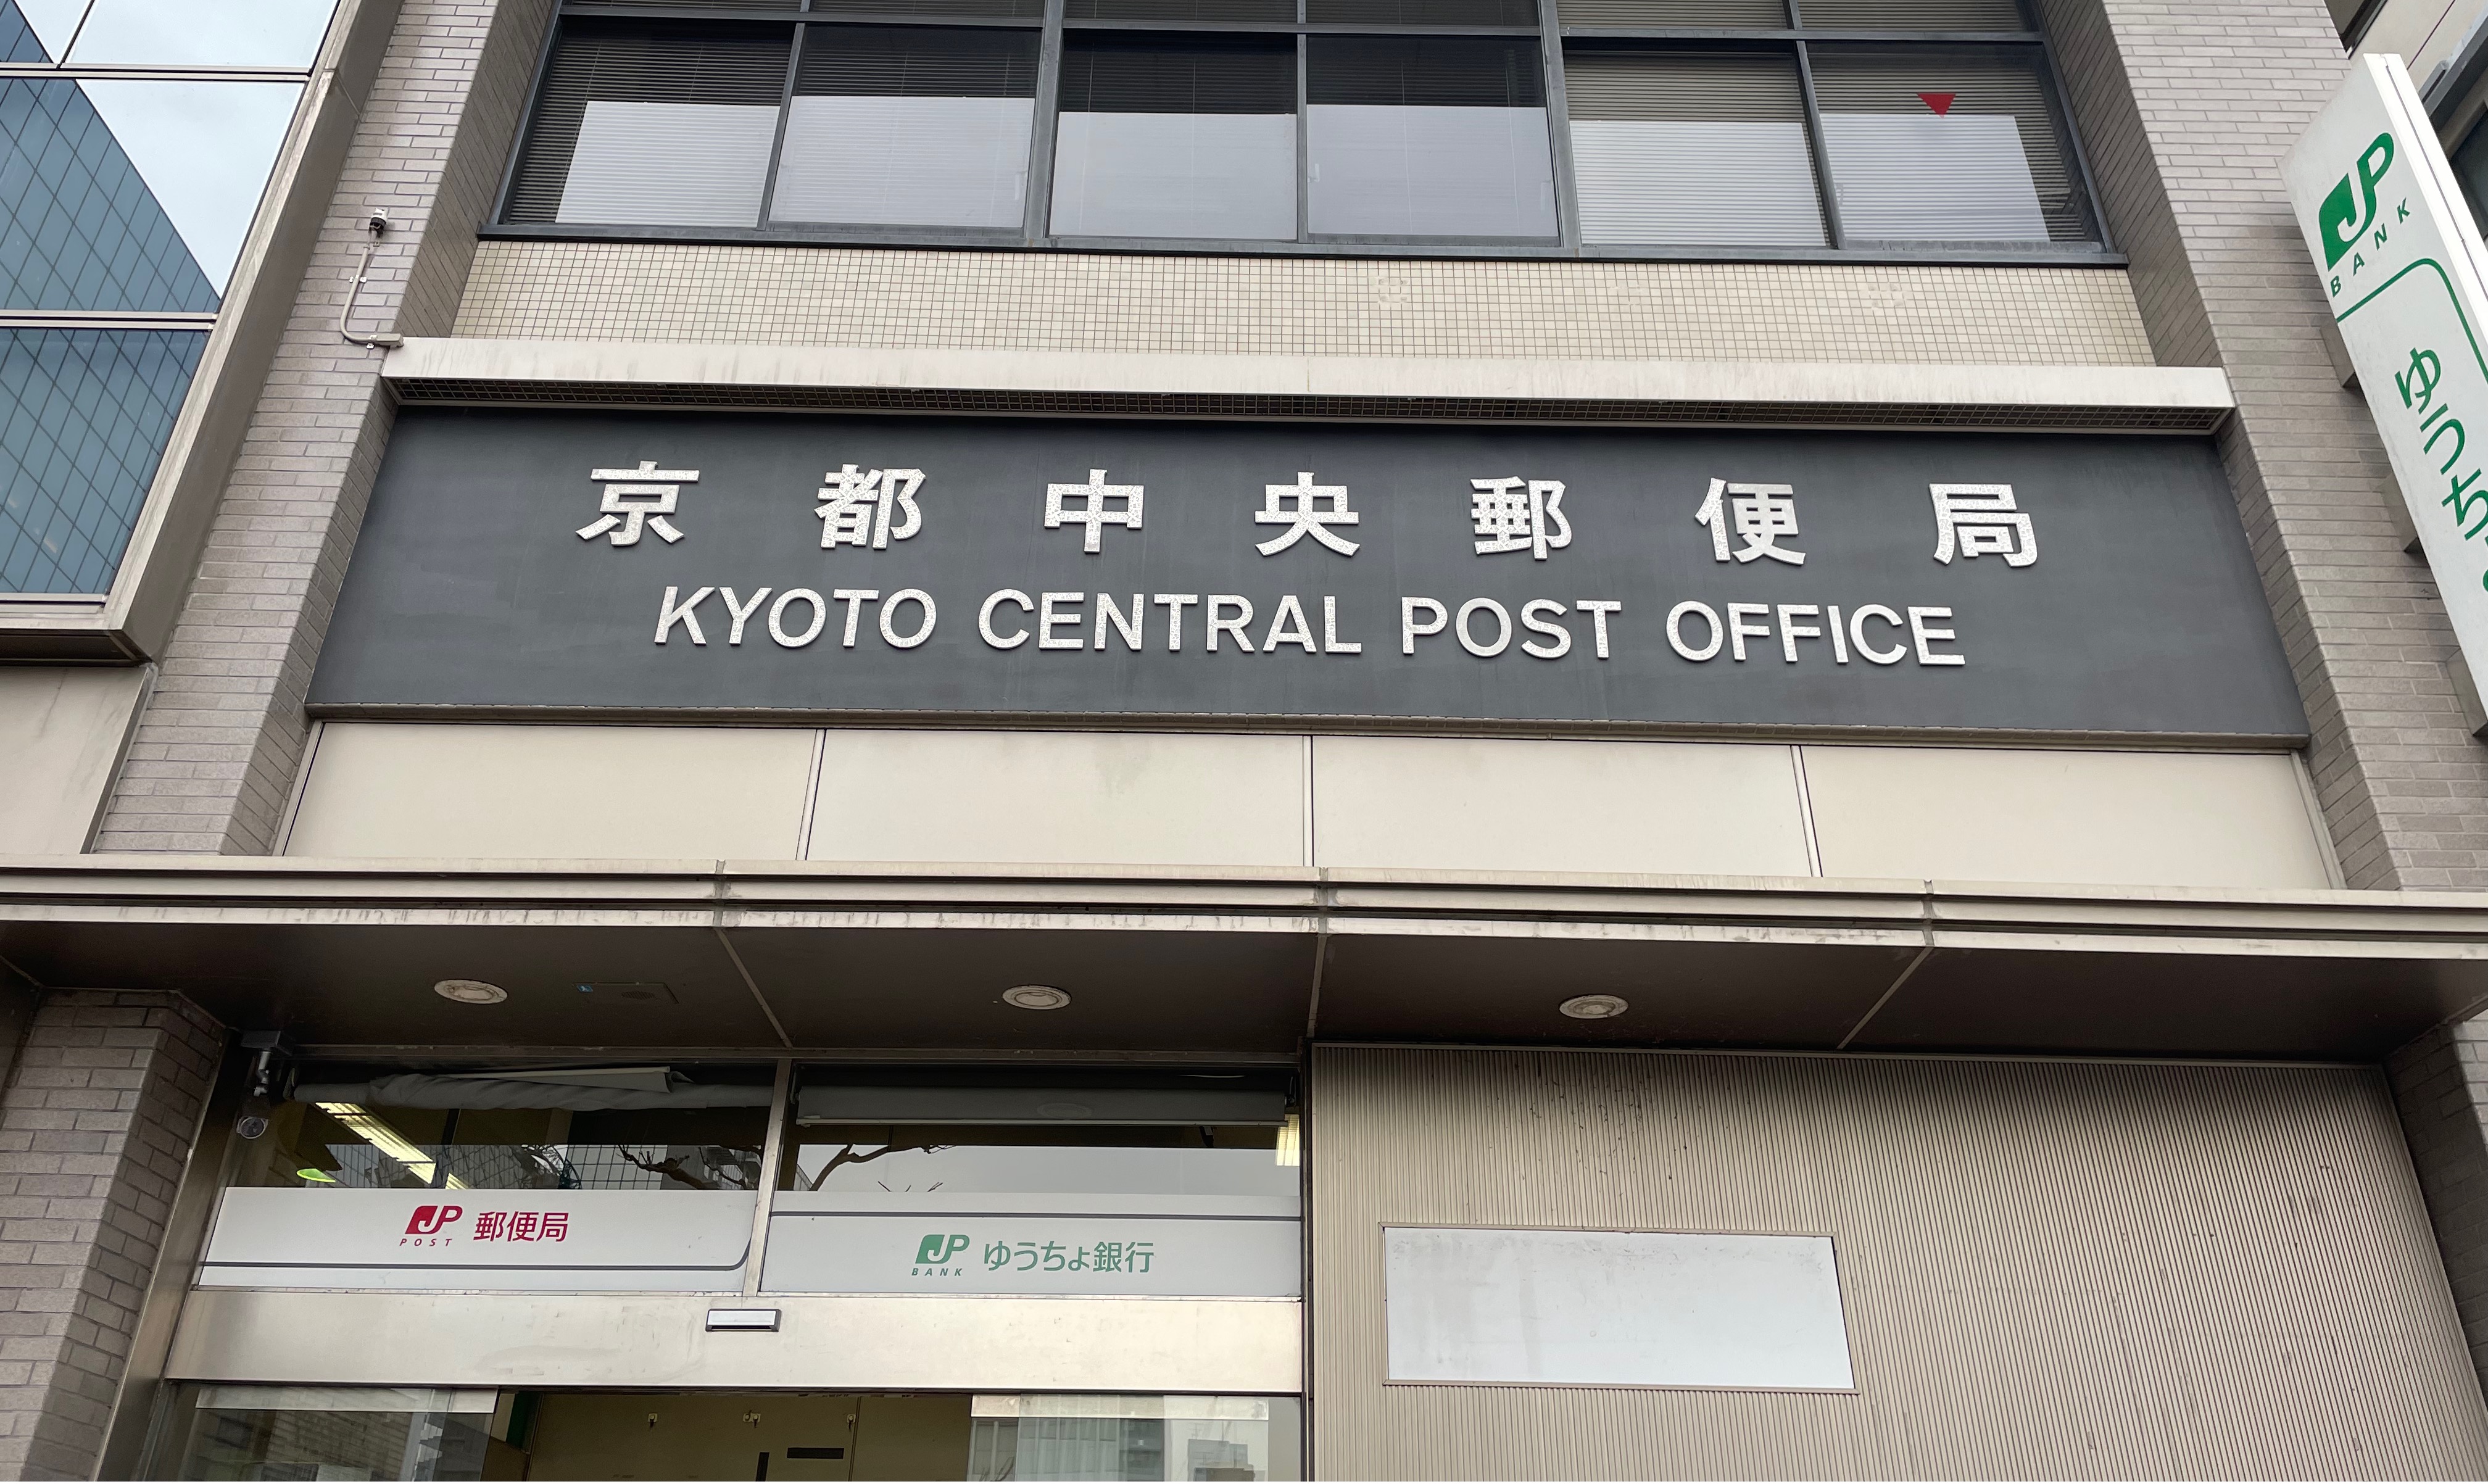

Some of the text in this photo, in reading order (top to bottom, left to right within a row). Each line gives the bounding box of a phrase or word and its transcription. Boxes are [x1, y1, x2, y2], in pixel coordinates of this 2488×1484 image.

[2330, 197, 2411, 298] BANK
[2395, 347, 2488, 593] ゆうち
[575, 460, 2039, 567] 京都中央郵便局
[653, 585, 1966, 666] KYOTO CENTRAL POST OFFICE
[399, 1238, 453, 1247] POST
[473, 1211, 569, 1243] 郵便局
[911, 1267, 963, 1277] BANK
[983, 1240, 1155, 1274] ゆうちょ銀行
